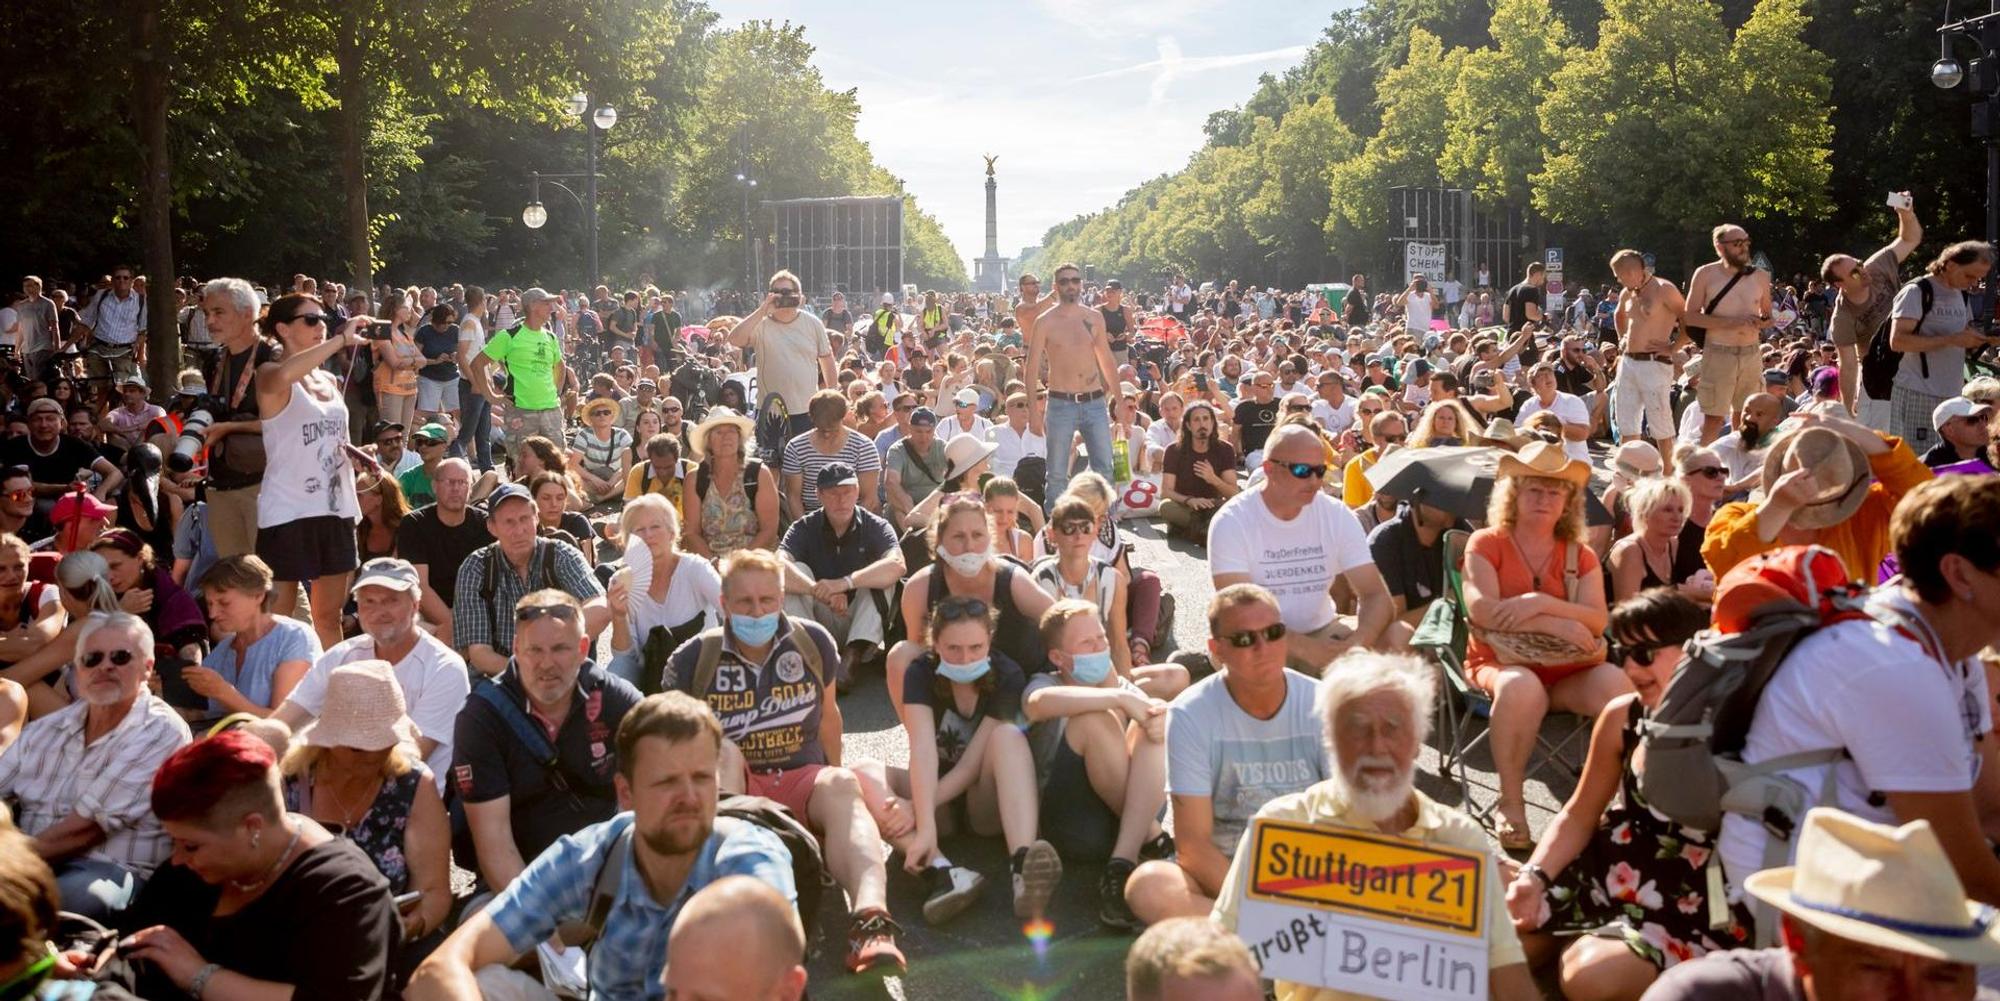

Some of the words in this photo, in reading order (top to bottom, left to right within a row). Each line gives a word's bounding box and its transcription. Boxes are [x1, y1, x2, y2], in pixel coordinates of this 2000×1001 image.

[1410, 246, 1445, 256] STOPP
[1548, 251, 1558, 262] P
[1410, 258, 1445, 268] CHEM-
[1410, 271, 1444, 281] TAILS
[716, 665, 747, 692] 63
[707, 690, 754, 711] FIELD
[739, 725, 804, 750] OTBALL
[1232, 759, 1311, 784] VISIONS
[1269, 842, 1416, 897] Stuttgart
[1427, 869, 1466, 907] 21
[1338, 930, 1476, 995] Berlin
